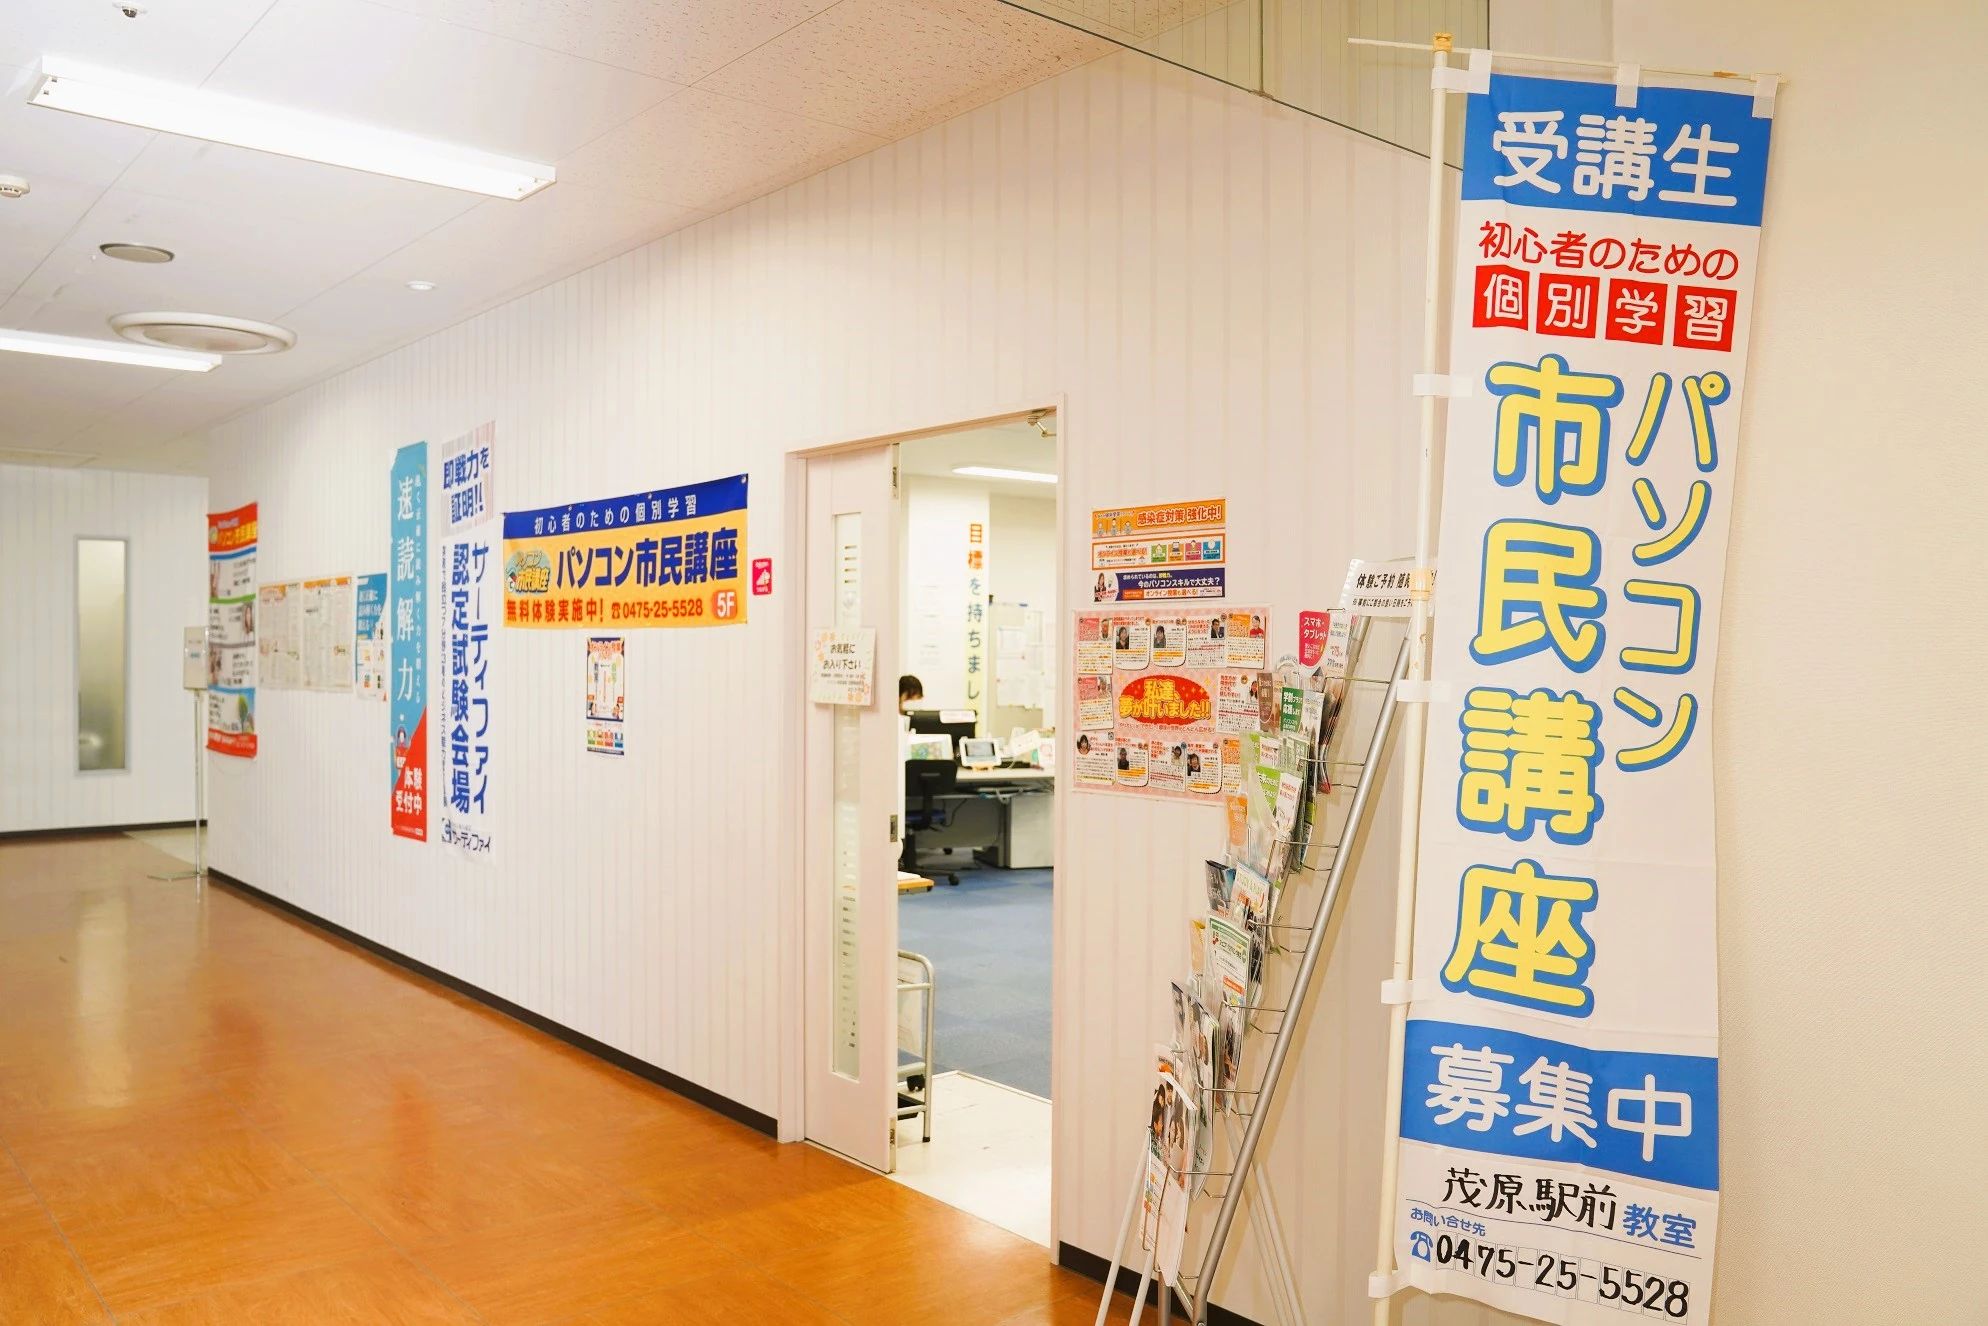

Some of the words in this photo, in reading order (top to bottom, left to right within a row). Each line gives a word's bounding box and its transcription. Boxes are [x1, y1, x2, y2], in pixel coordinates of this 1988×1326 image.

[1492, 110, 1740, 207] 受講生
[1477, 220, 1740, 281] 初心者のための
[1483, 273, 1729, 343] 個別学習
[443, 447, 489, 490] 即戦力を
[533, 493, 698, 536] 初心者のための個別学習
[1137, 509, 1185, 526] 感染症対策
[396, 476, 415, 702] 速読解力
[556, 527, 739, 590] パソコン市民講座
[1612, 369, 1731, 773] パソコン
[506, 597, 604, 623] 無料体験実施中!
[623, 598, 704, 619] 0475-25-5528
[716, 590, 736, 617] 5F
[450, 541, 470, 815] 認定試験会場
[471, 540, 490, 815] サーティファイ
[823, 659, 862, 670] お入り下さい
[830, 643, 856, 654] お気軽に
[1118, 695, 1212, 720] 夢が叶いました!!
[1439, 352, 1625, 1019] 市民講座
[396, 790, 423, 816] 受付中
[1425, 1042, 1693, 1163] 募集中
[1409, 1206, 1487, 1238] お問い合せ先
[1441, 1167, 1620, 1231] 茂原駅前
[1621, 1203, 1697, 1250] 教室
[1436, 1234, 1690, 1318] 0475-25-5528
